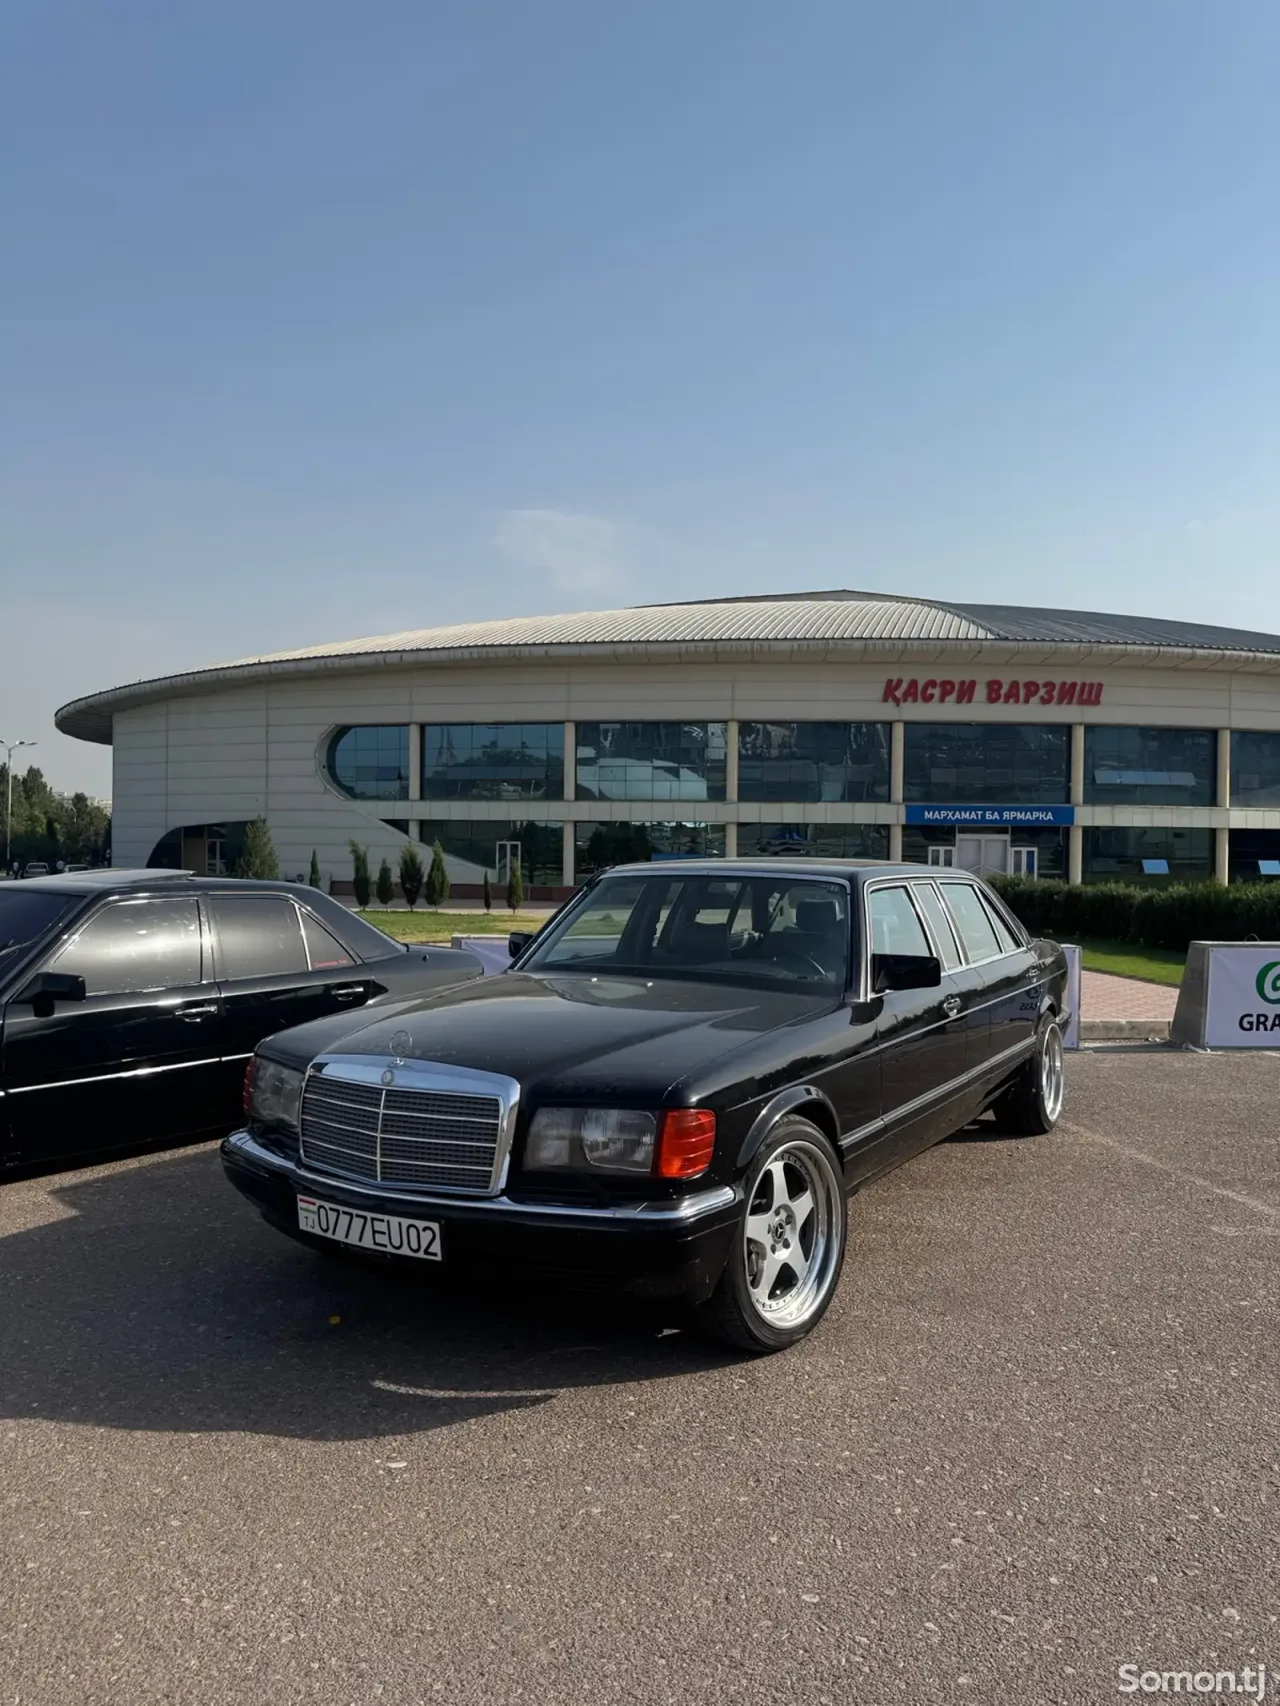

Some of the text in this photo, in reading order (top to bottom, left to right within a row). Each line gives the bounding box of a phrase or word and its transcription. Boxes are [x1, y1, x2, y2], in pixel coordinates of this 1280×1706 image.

[882, 679, 1104, 707] ҚАСРИ ВАРЗИШ
[924, 811, 1054, 820] МАРҲАМАТ БА ЯРМАРКА
[304, 1216, 315, 1229] TJ
[317, 1205, 438, 1257] 0777EU02
